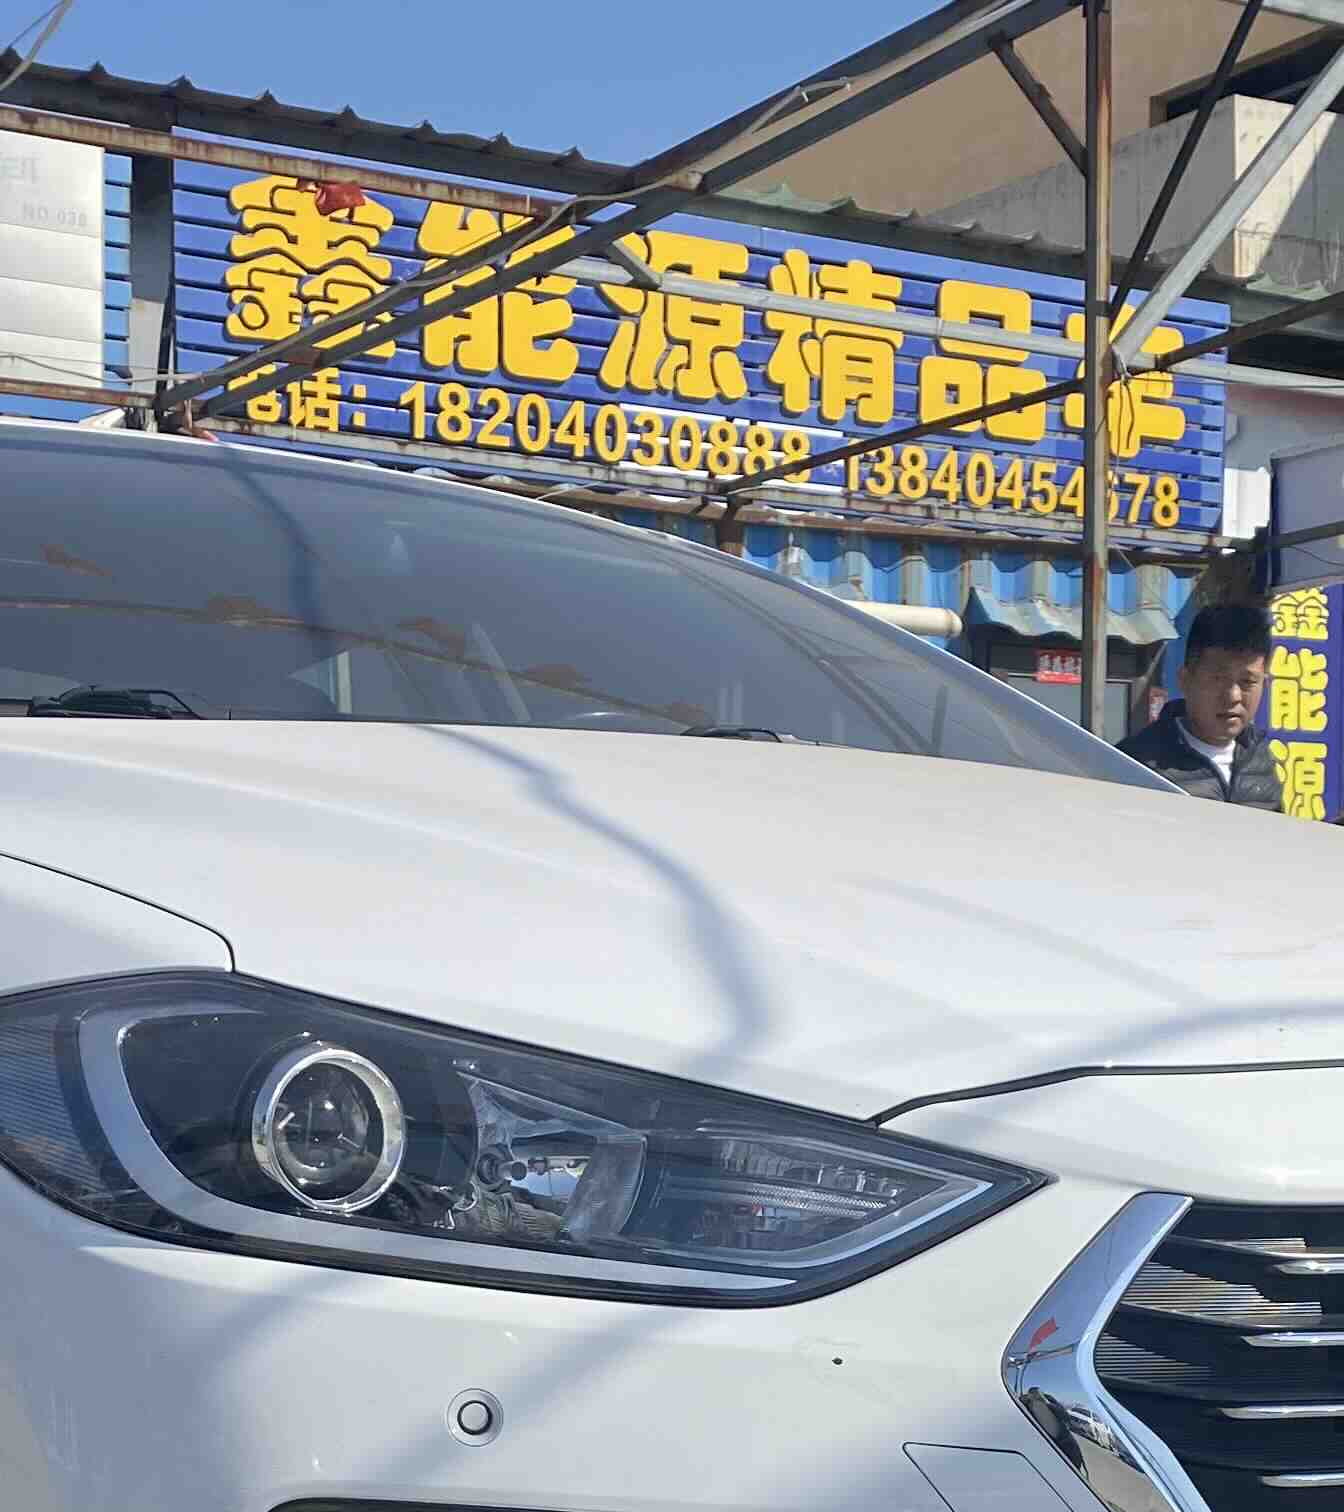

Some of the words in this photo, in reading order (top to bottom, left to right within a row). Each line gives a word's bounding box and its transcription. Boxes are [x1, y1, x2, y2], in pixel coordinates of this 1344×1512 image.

[399, 380, 810, 483] 18204030888
[1269, 587, 1329, 821] 鑫能源
